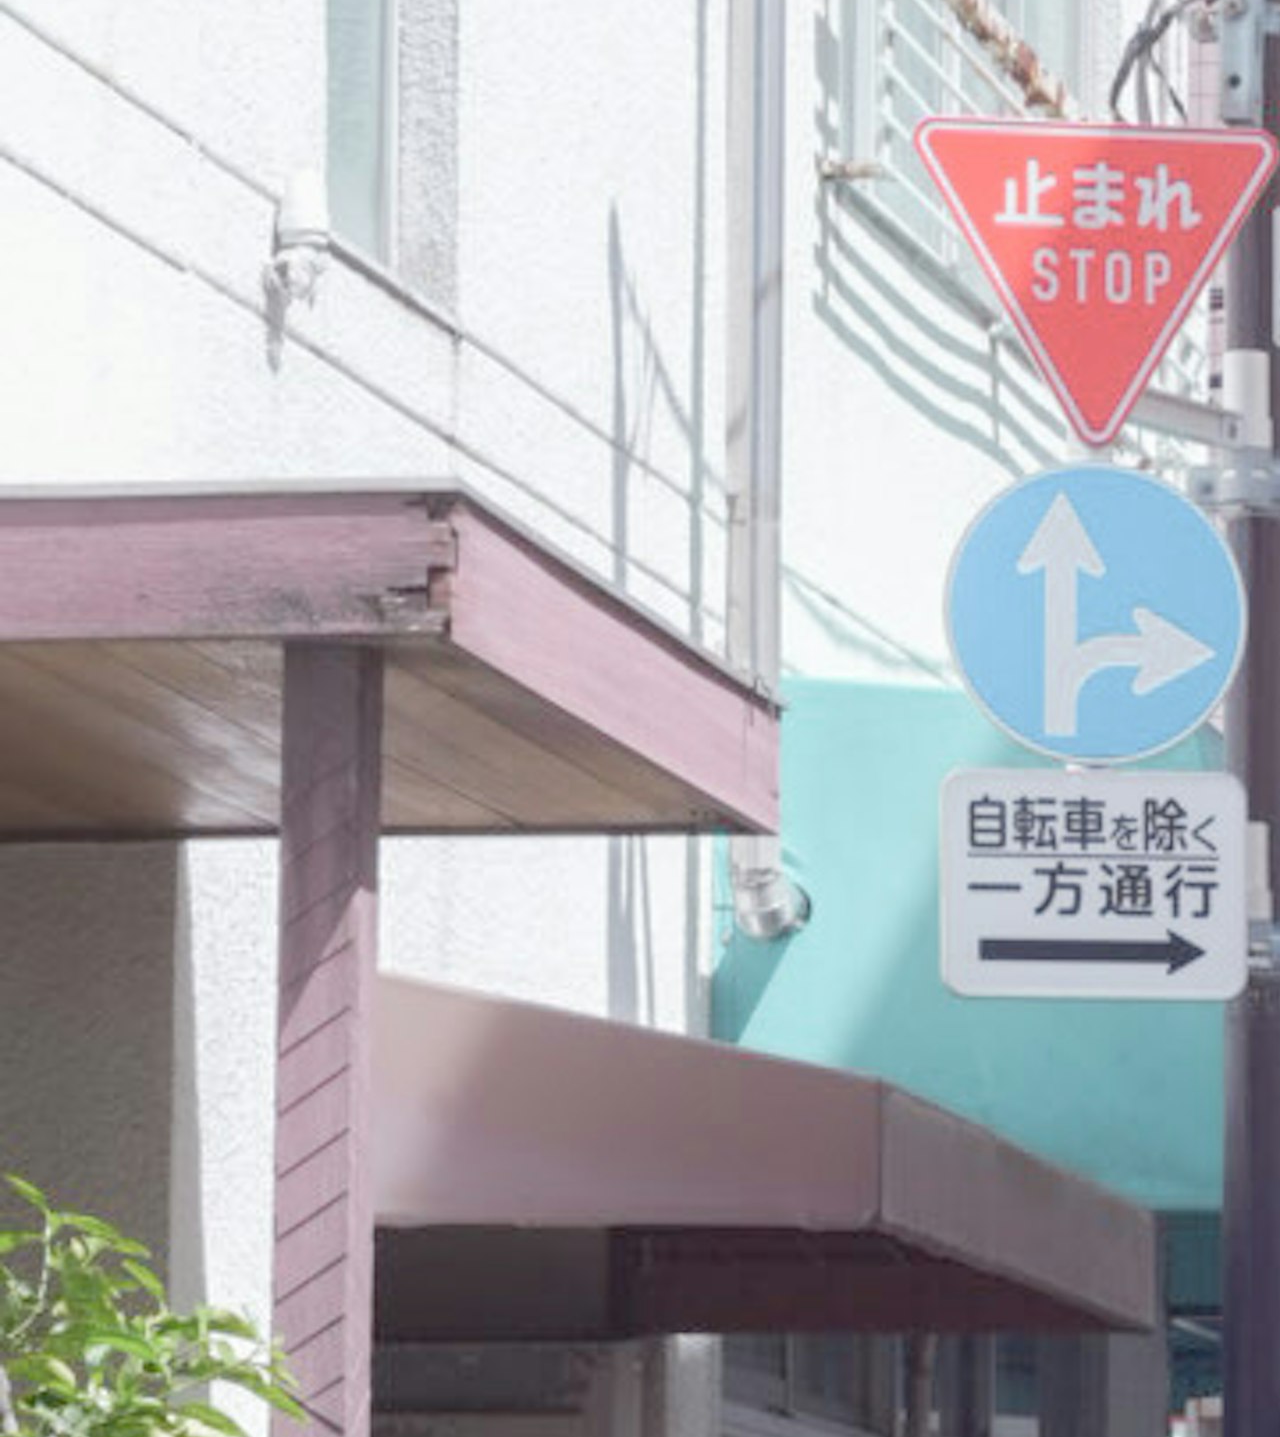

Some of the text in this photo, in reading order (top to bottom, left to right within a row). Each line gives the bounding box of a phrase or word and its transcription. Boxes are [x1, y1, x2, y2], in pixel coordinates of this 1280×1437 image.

[994, 157, 1202, 231] 止まれ
[1032, 247, 1172, 305] STOP
[969, 795, 1217, 852] 自転車を除く
[967, 862, 1219, 918] 一方通行
